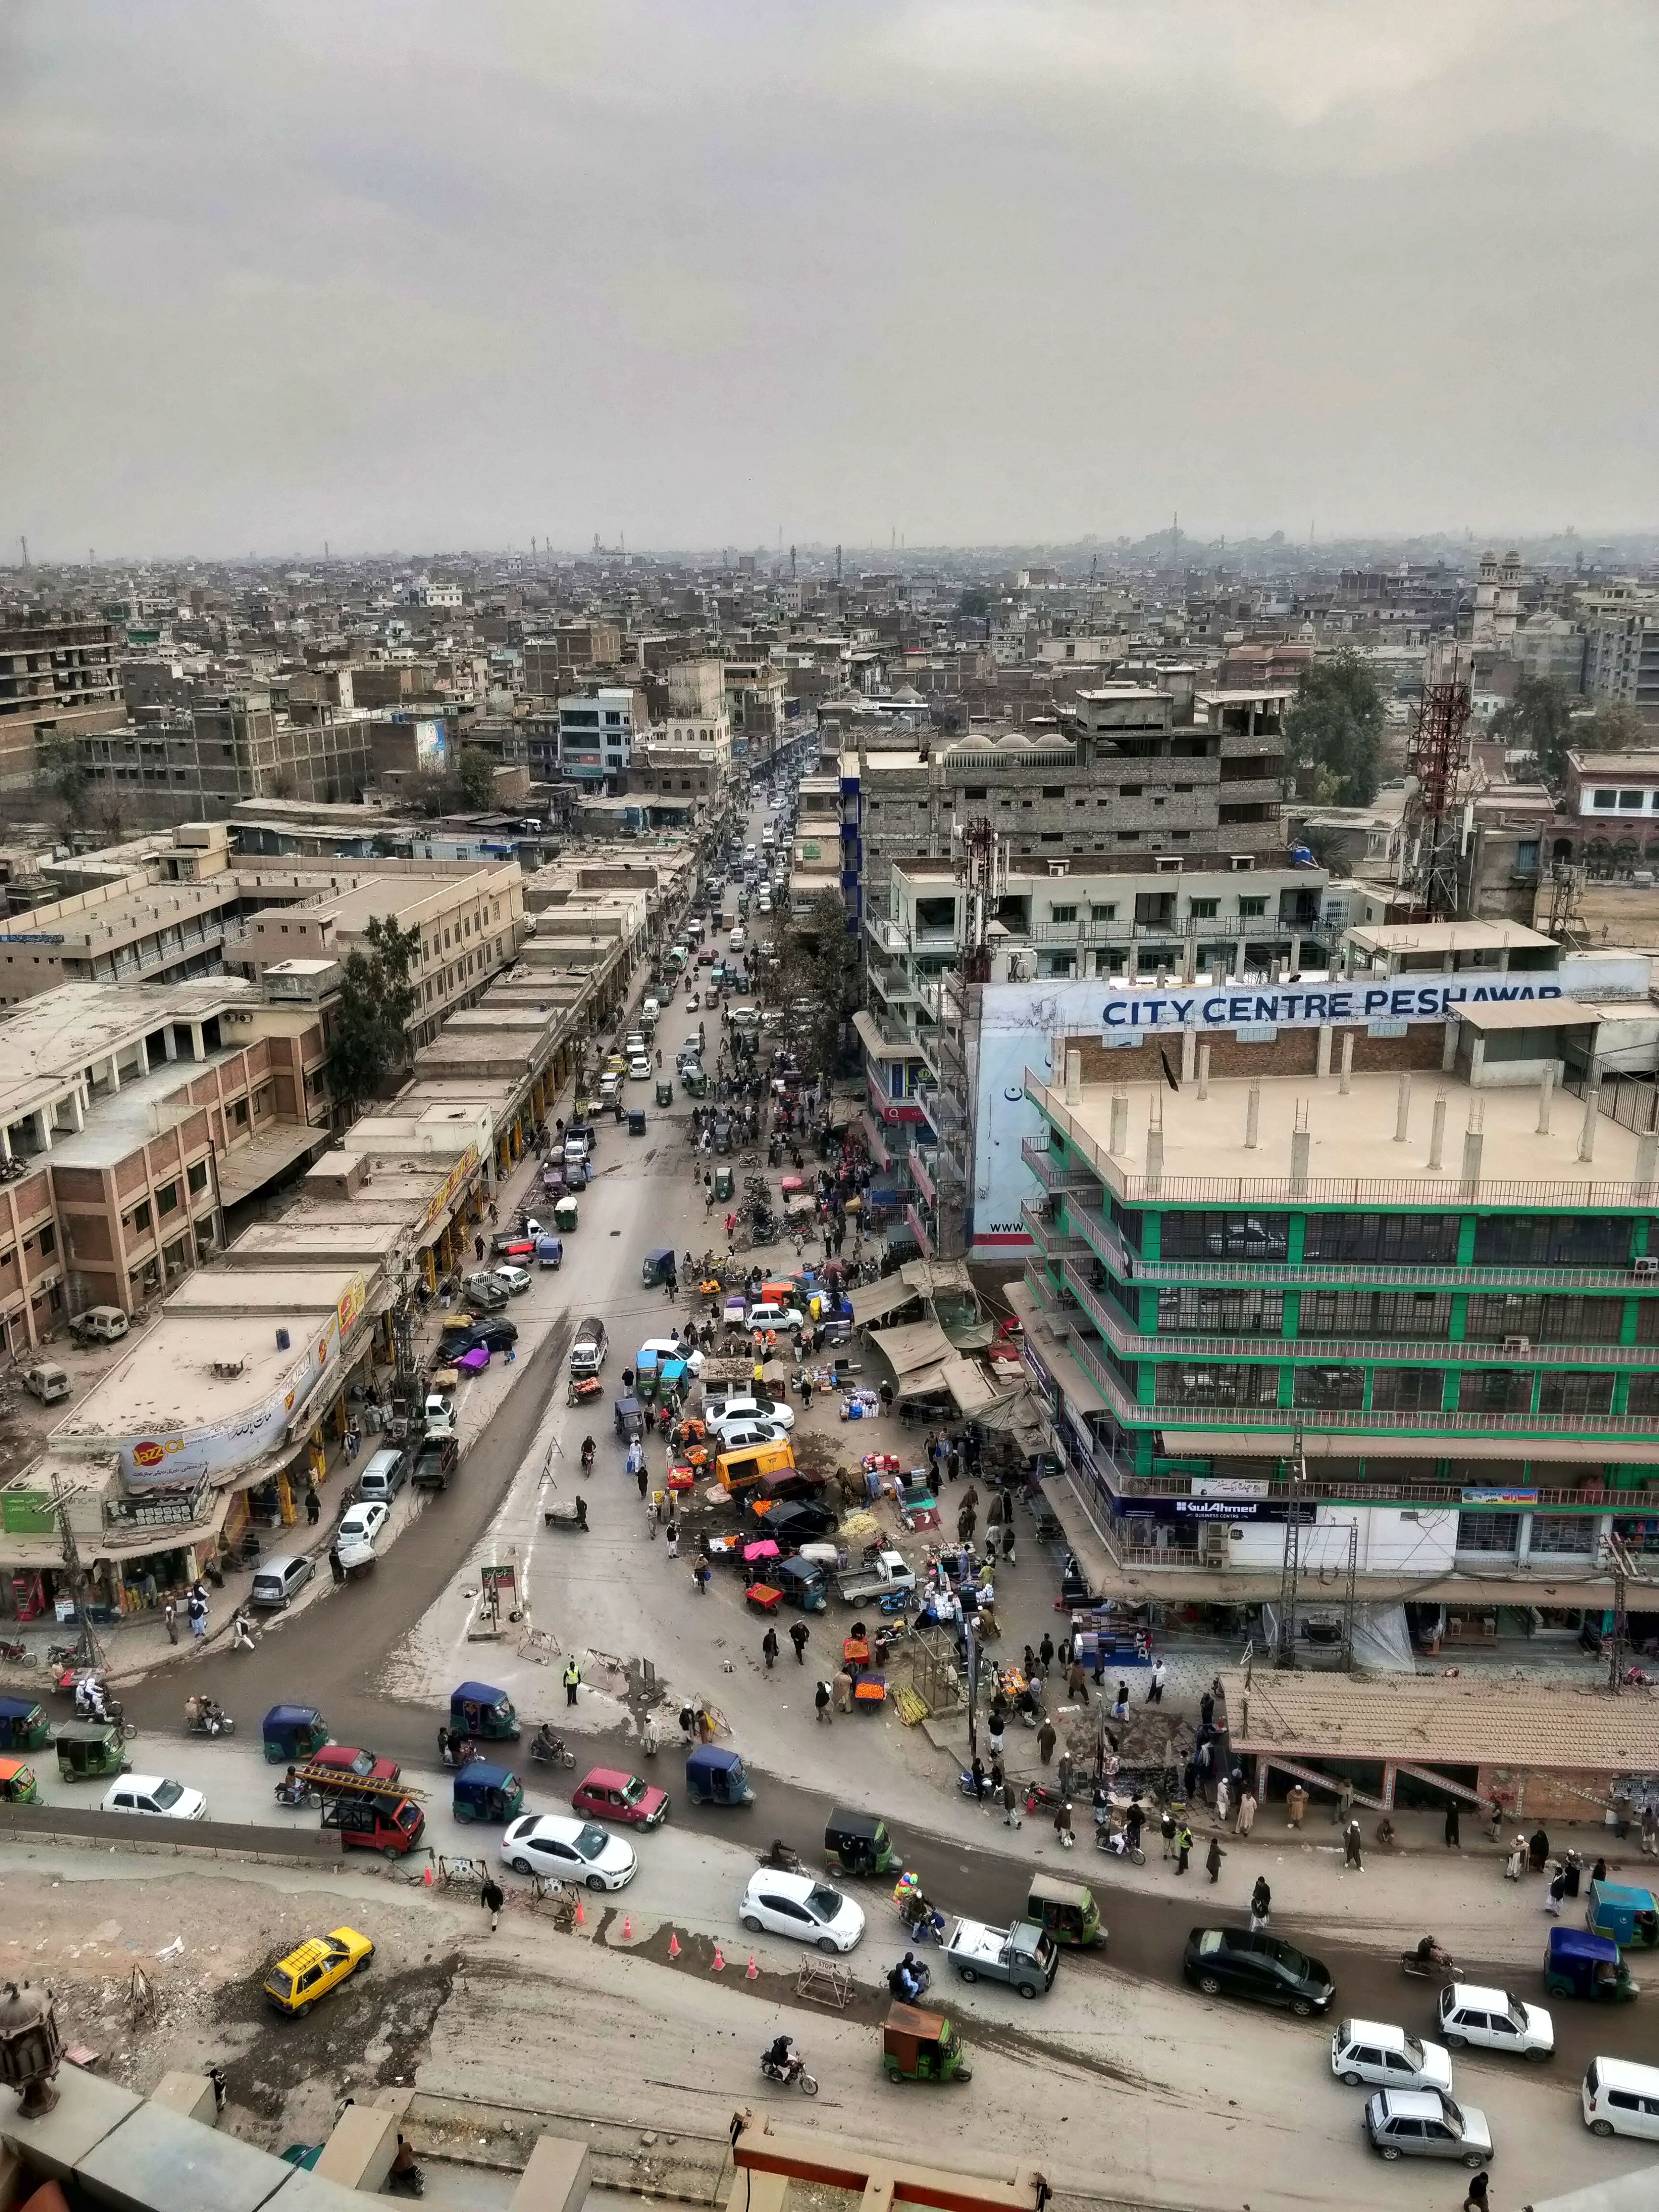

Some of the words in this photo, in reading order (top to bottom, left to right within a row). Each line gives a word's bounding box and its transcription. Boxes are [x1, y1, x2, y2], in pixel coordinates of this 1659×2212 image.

[1103, 999, 1195, 1025] CITY
[1203, 992, 1353, 1022] CENTRE
[132, 1445, 164, 1466] Jazz
[1187, 1503, 1257, 1513] GulAhmed
[818, 1960, 833, 1970] STOP
